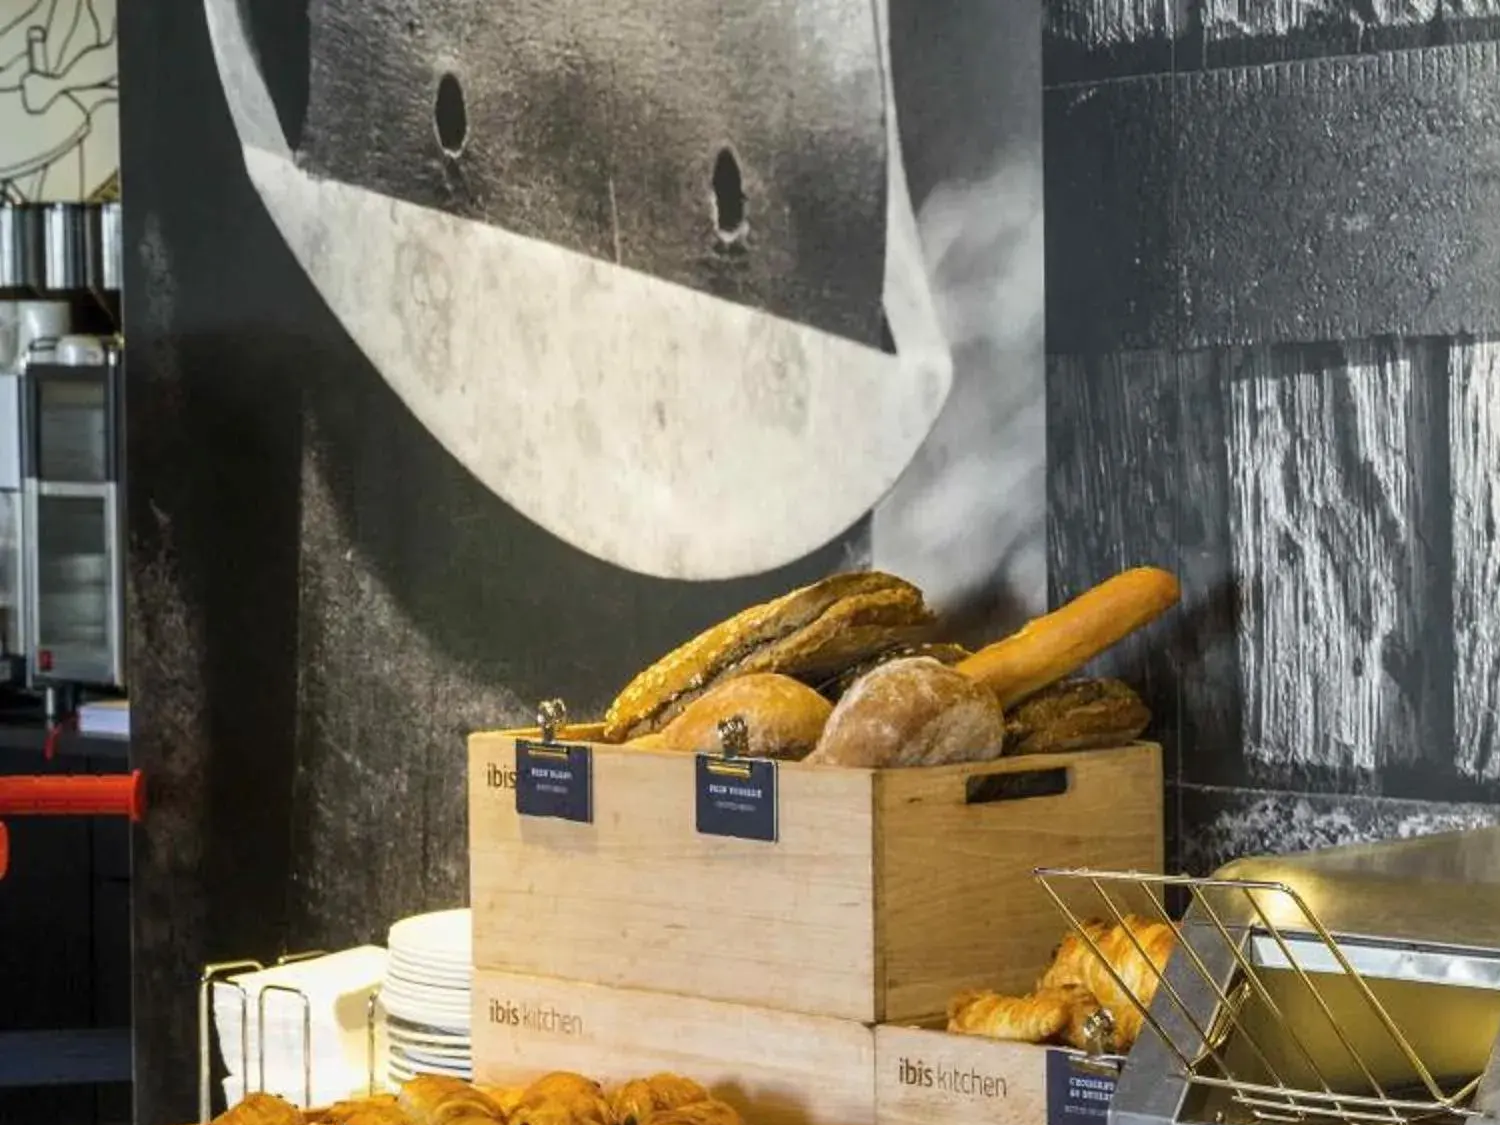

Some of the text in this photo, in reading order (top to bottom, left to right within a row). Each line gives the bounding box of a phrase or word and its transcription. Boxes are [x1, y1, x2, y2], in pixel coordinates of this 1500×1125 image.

[486, 763, 517, 789] ibis
[489, 998, 584, 1036] ibis kitchen
[899, 1057, 1008, 1099] ibis kitchen
